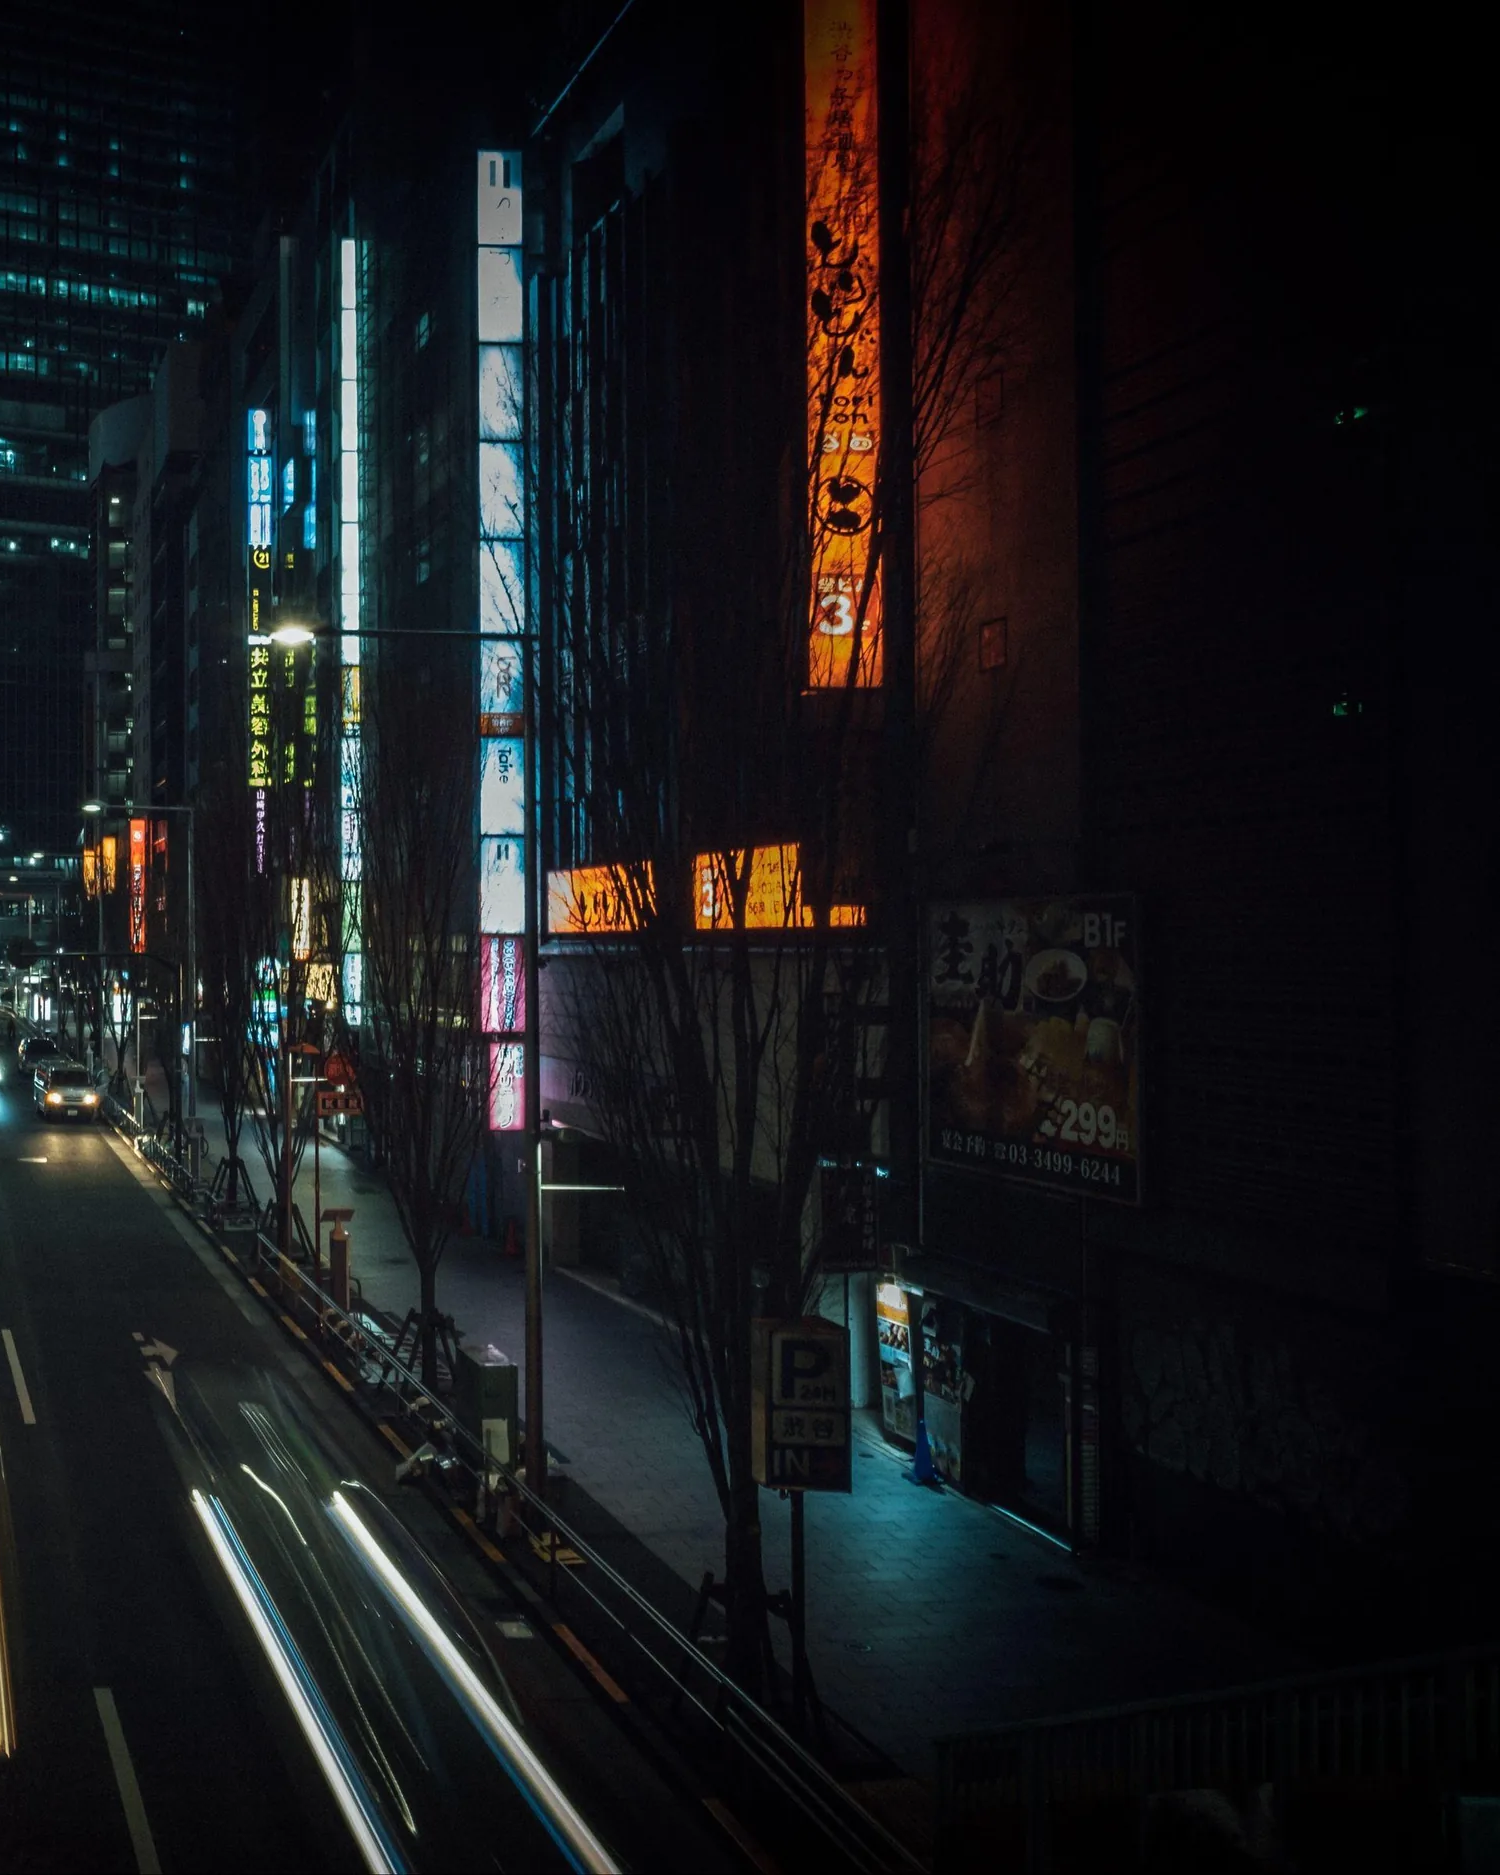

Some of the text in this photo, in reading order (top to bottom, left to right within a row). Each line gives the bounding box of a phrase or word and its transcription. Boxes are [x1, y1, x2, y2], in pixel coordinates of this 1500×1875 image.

[1084, 912, 1127, 949] B1F
[1008, 1143, 1121, 1186] 03-3499-6244
[782, 1340, 831, 1399] P
[773, 1450, 810, 1478] IN
